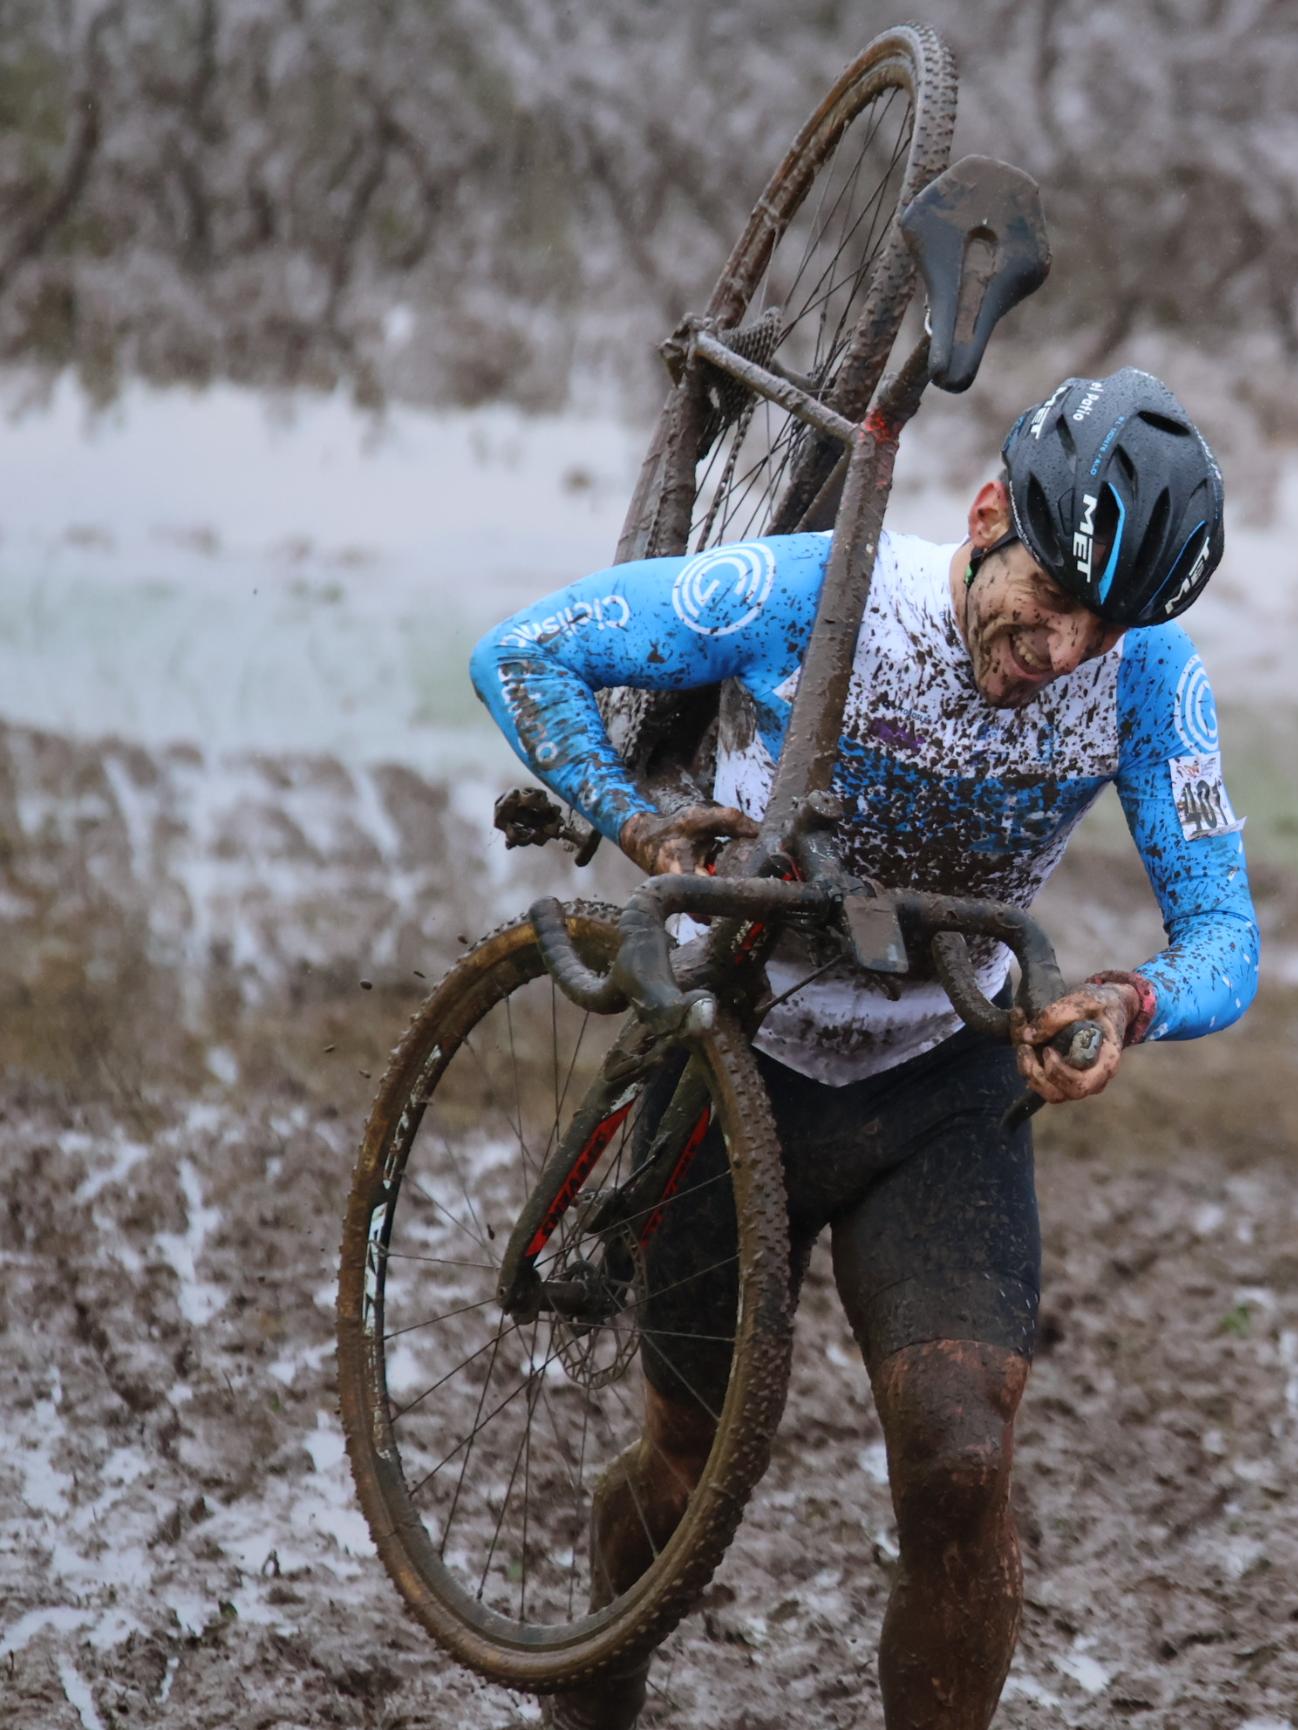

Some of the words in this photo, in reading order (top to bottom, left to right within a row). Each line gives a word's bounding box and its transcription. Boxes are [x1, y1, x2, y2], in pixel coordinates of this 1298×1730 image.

[1030, 386, 1068, 440] MET
[1072, 394, 1100, 422] Patio
[1091, 381, 1104, 394] el
[1073, 493, 1098, 583] MET
[1165, 536, 1210, 614] MET
